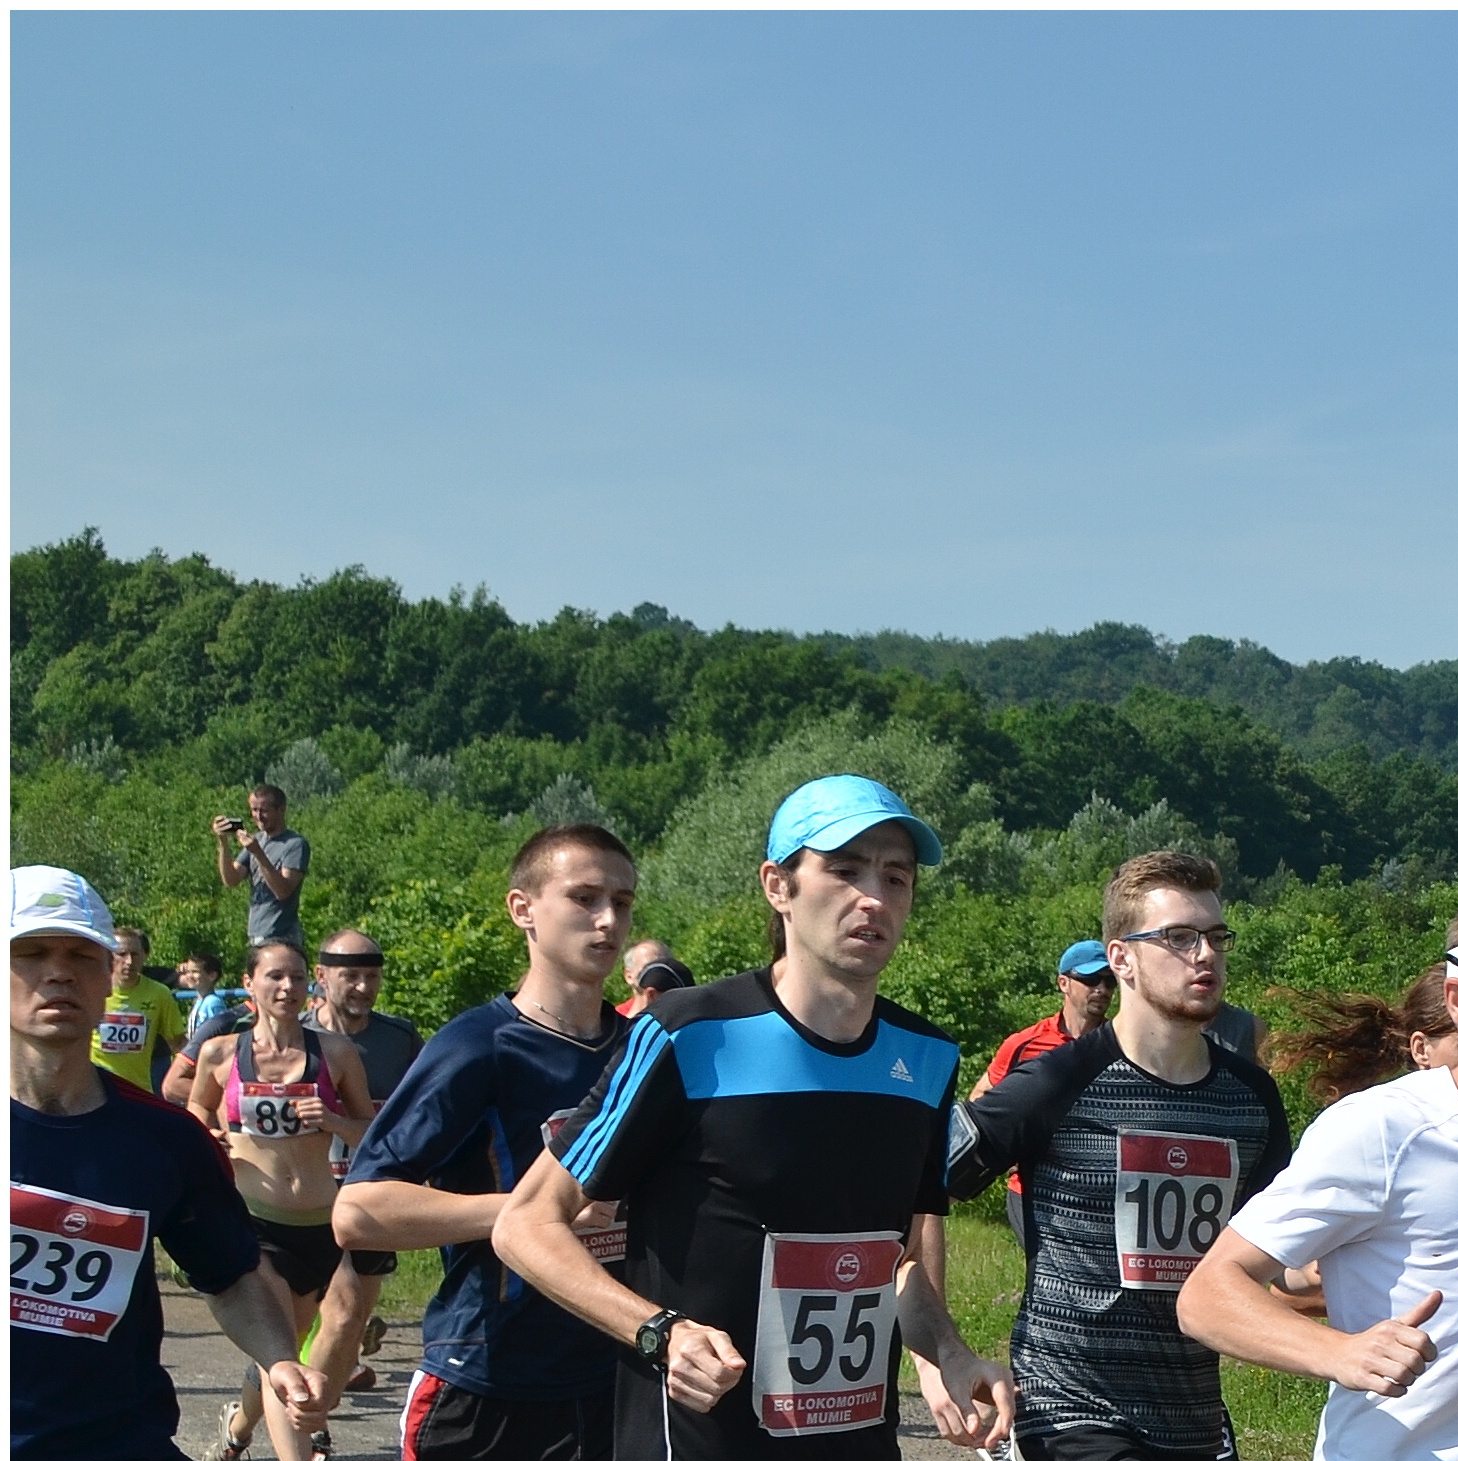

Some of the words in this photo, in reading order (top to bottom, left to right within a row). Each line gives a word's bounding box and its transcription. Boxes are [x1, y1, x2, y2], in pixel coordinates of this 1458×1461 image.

[107, 1026, 139, 1043] 260
[256, 1101, 300, 1135] 89
[1125, 1178, 1223, 1254] 108
[10, 1234, 113, 1302] 239
[1128, 1257, 1145, 1268] EC
[1148, 1258, 1199, 1270] LOKOMOT
[12, 1297, 96, 1323] LOKOMOTIVA
[19, 1310, 64, 1327] MUMIE
[788, 1292, 881, 1385] 55
[774, 1399, 793, 1412] EC
[797, 1391, 877, 1410] LOKOMOTIVA
[806, 1410, 851, 1425] MUMIE
